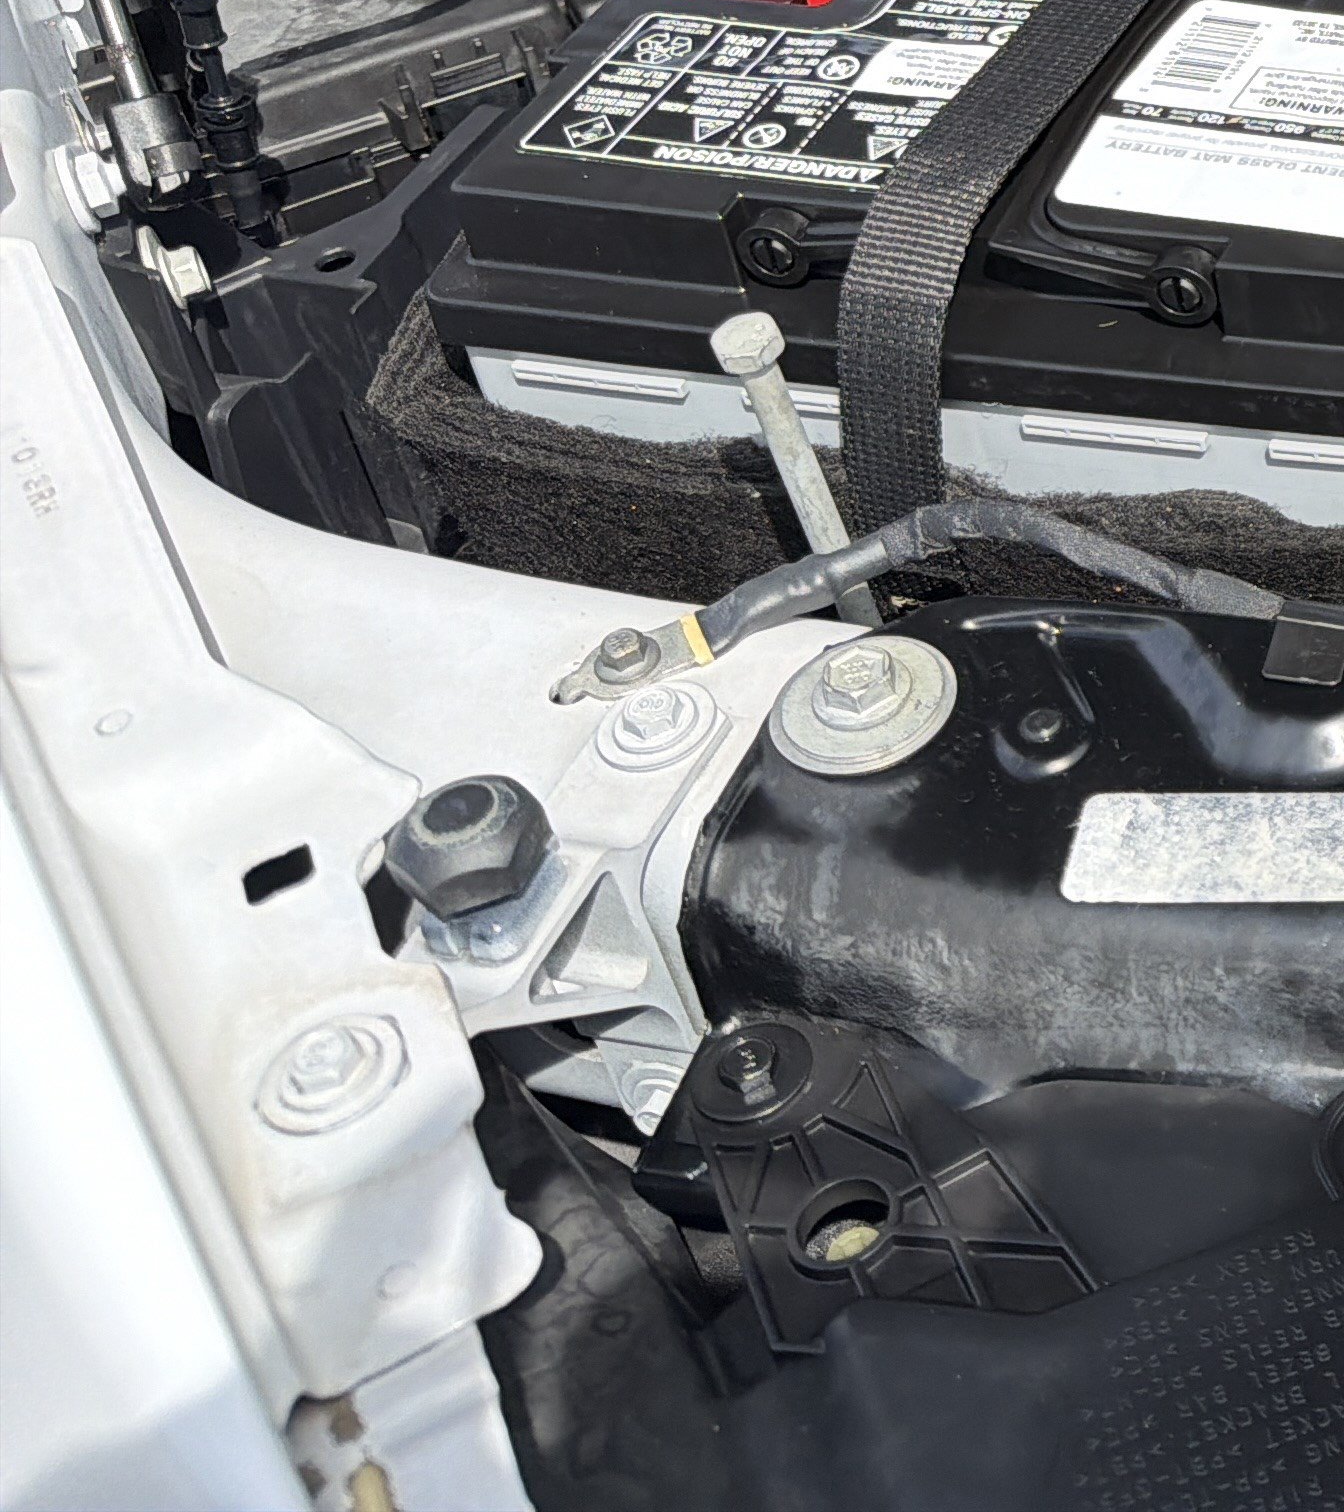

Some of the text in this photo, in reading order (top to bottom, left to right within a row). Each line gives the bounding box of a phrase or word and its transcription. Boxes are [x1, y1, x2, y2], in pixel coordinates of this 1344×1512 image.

[911, 2, 1030, 20] ON-SPILLABLE
[976, 0, 1008, 8] Acid
[724, 33, 767, 47] OPEN.
[946, 32, 984, 41] READ
[716, 44, 753, 57] NOT
[711, 55, 737, 67] DO
[643, 70, 672, 80] HELP
[639, 78, 664, 88] GET
[730, 79, 769, 91] SEVERE
[705, 87, 761, 100] BLINDNESS
[694, 96, 728, 107] CAUSE
[1141, 107, 1164, 117] 70
[1197, 113, 1226, 125] 120
[1272, 121, 1306, 135] 950
[1104, 139, 1188, 159] BATTERY
[653, 144, 858, 178] DANGER/POISON
[1188, 150, 1233, 165] MAT
[1236, 155, 1297, 172] GLASS
[1213, 1228, 1317, 1282] REFLEX
[1194, 1307, 1266, 1349] LENS
[1217, 1322, 1309, 1371] REFLS
[1246, 1342, 1334, 1392] BEZEL
[1173, 1383, 1230, 1421] BAR
[1178, 1383, 1309, 1450] BRACKET
